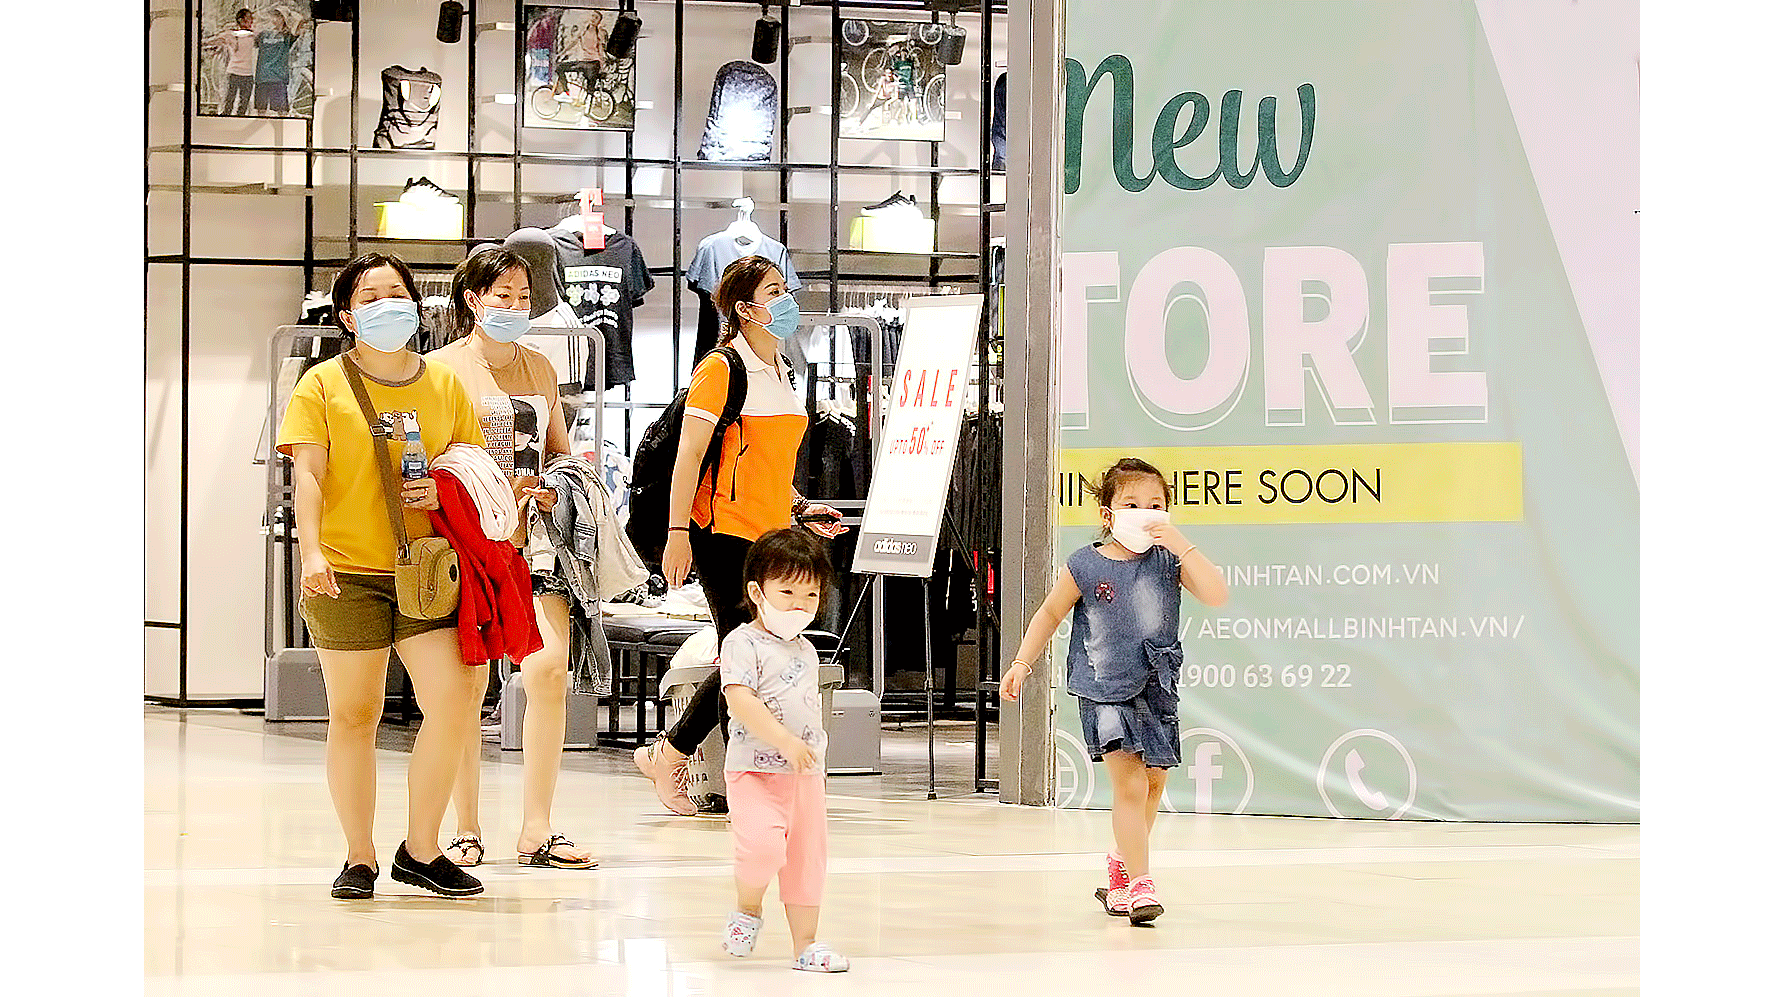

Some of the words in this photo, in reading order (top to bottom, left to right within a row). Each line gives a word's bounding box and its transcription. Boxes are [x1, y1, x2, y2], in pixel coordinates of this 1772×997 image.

[567, 270, 600, 279] ADIDAS
[602, 271, 620, 280] NEO
[900, 369, 958, 408] SALE
[931, 440, 945, 455] OFF
[1257, 468, 1381, 504] SOON
[874, 537, 901, 554] adidas
[902, 542, 917, 555] neo
[1215, 564, 1440, 586] INHTAN.COM.VN
[1243, 664, 1273, 687] 63
[1281, 663, 1313, 687] 69
[1321, 664, 1352, 687] 22
